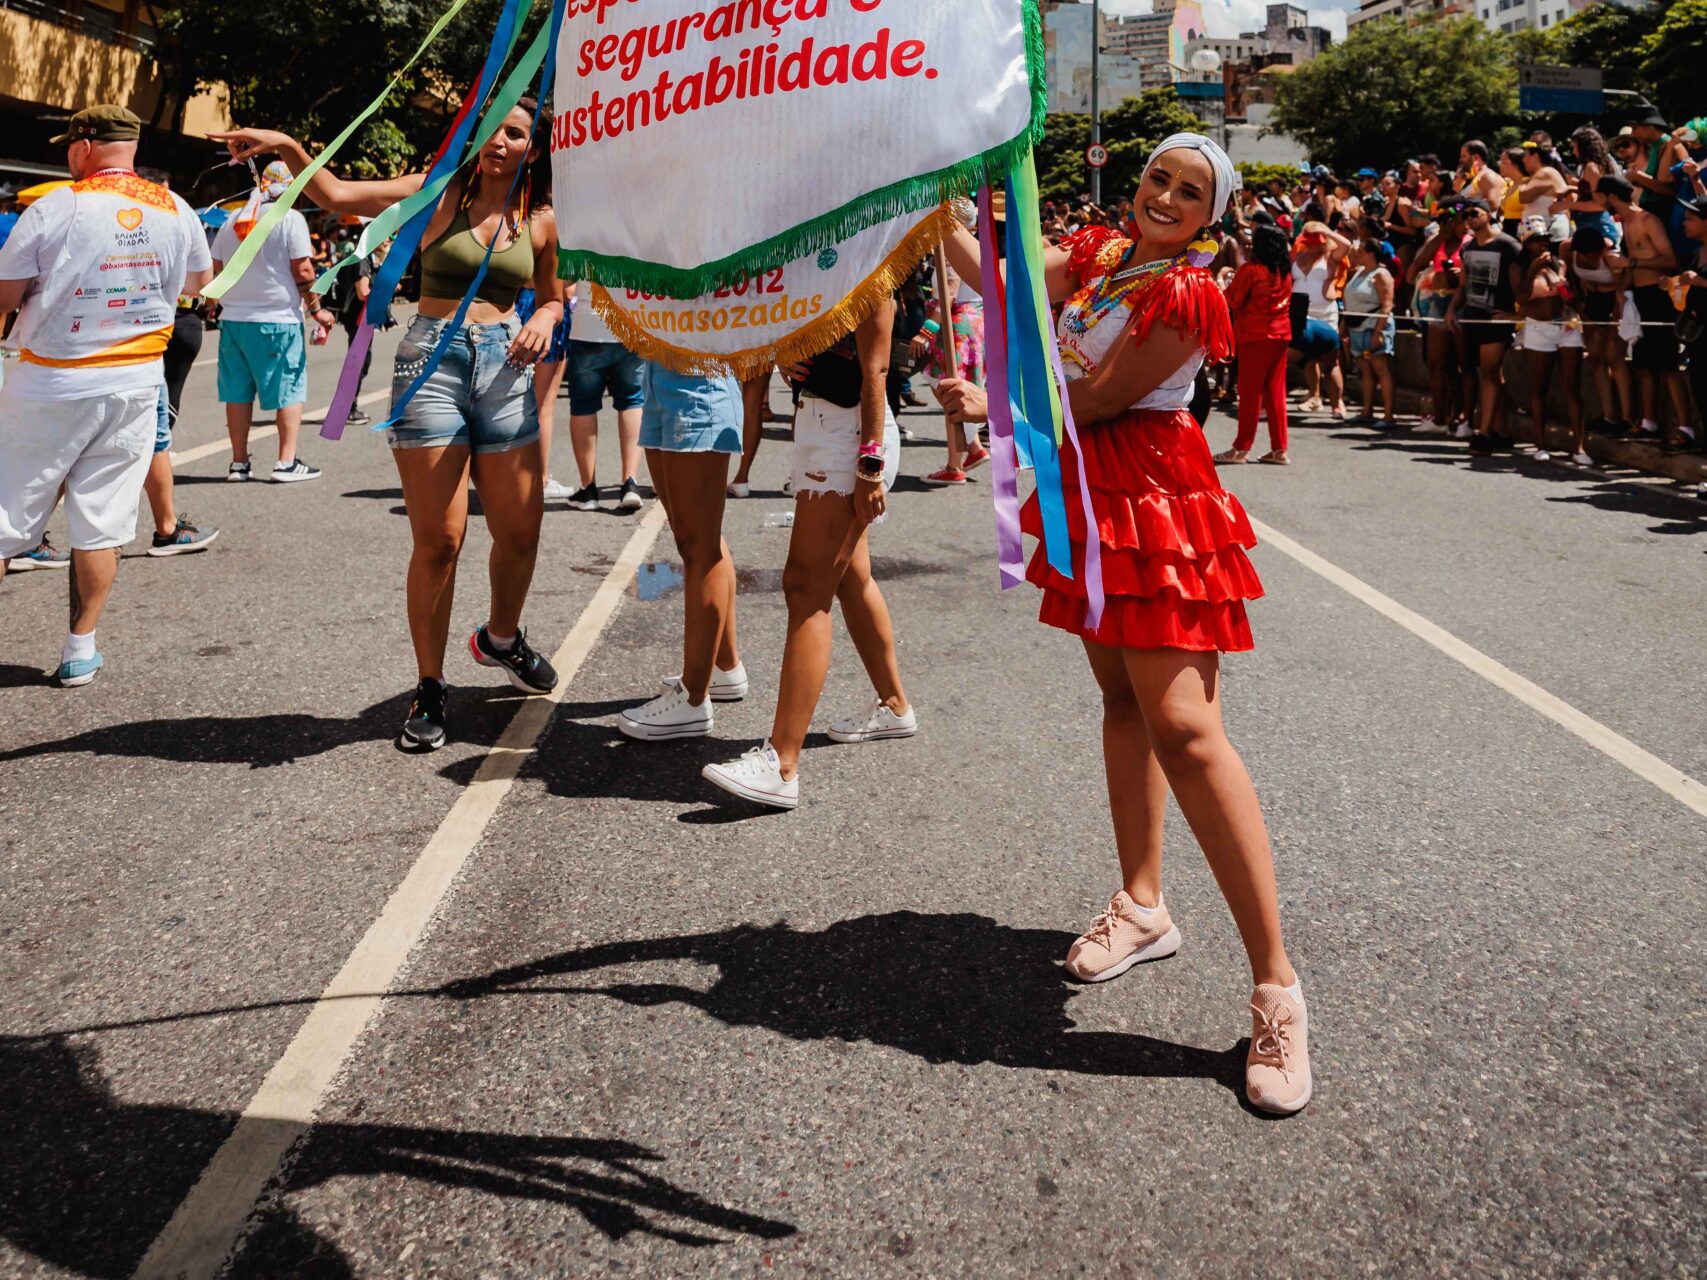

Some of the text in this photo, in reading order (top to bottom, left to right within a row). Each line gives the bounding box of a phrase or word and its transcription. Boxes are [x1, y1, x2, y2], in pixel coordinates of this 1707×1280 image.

[551, 28, 938, 153] sustentabilidade.
[1091, 150, 1104, 159] 60
[630, 294, 823, 333] aianasozadas
